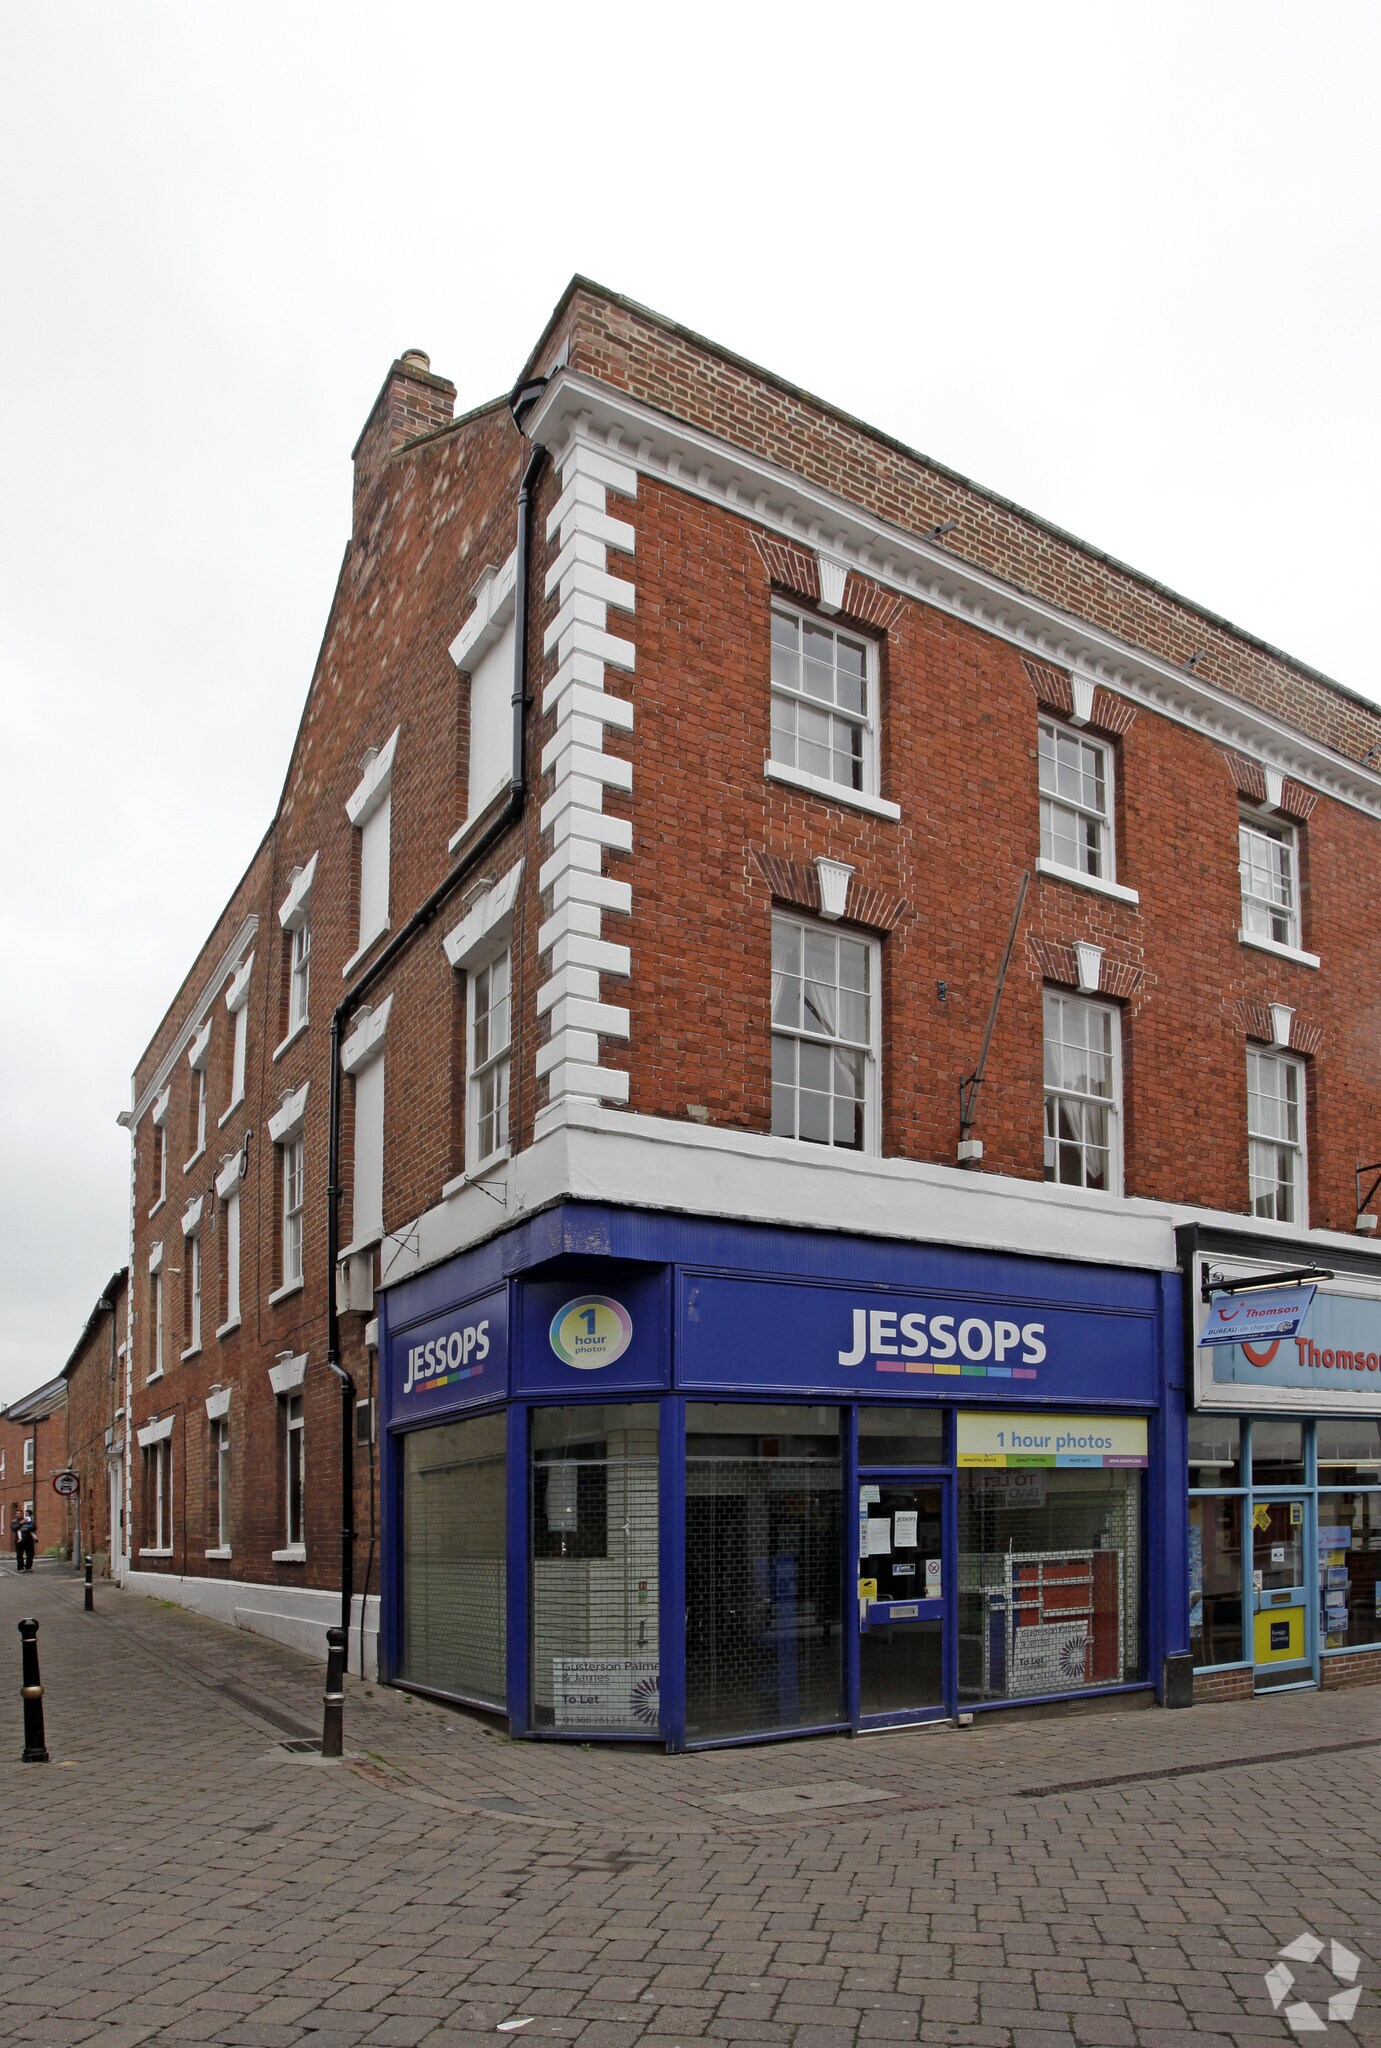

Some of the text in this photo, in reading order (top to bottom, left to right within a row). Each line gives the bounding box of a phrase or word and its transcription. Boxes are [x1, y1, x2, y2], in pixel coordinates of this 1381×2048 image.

[1245, 1305, 1299, 1318] Thomson
[579, 1308, 596, 1335] 1
[1208, 1323, 1275, 1335] BUREAU de change
[575, 1335, 607, 1345] hour
[838, 1308, 1047, 1366] JESSOPS
[404, 1320, 490, 1393] JESSOPS
[575, 1346, 607, 1355] photos
[1295, 1337, 1381, 1371] Thomso
[996, 1431, 1112, 1452] 1 hour photos
[562, 1661, 621, 1671] Gusterson
[562, 1672, 610, 1682] & James
[562, 1695, 600, 1704] To Let
